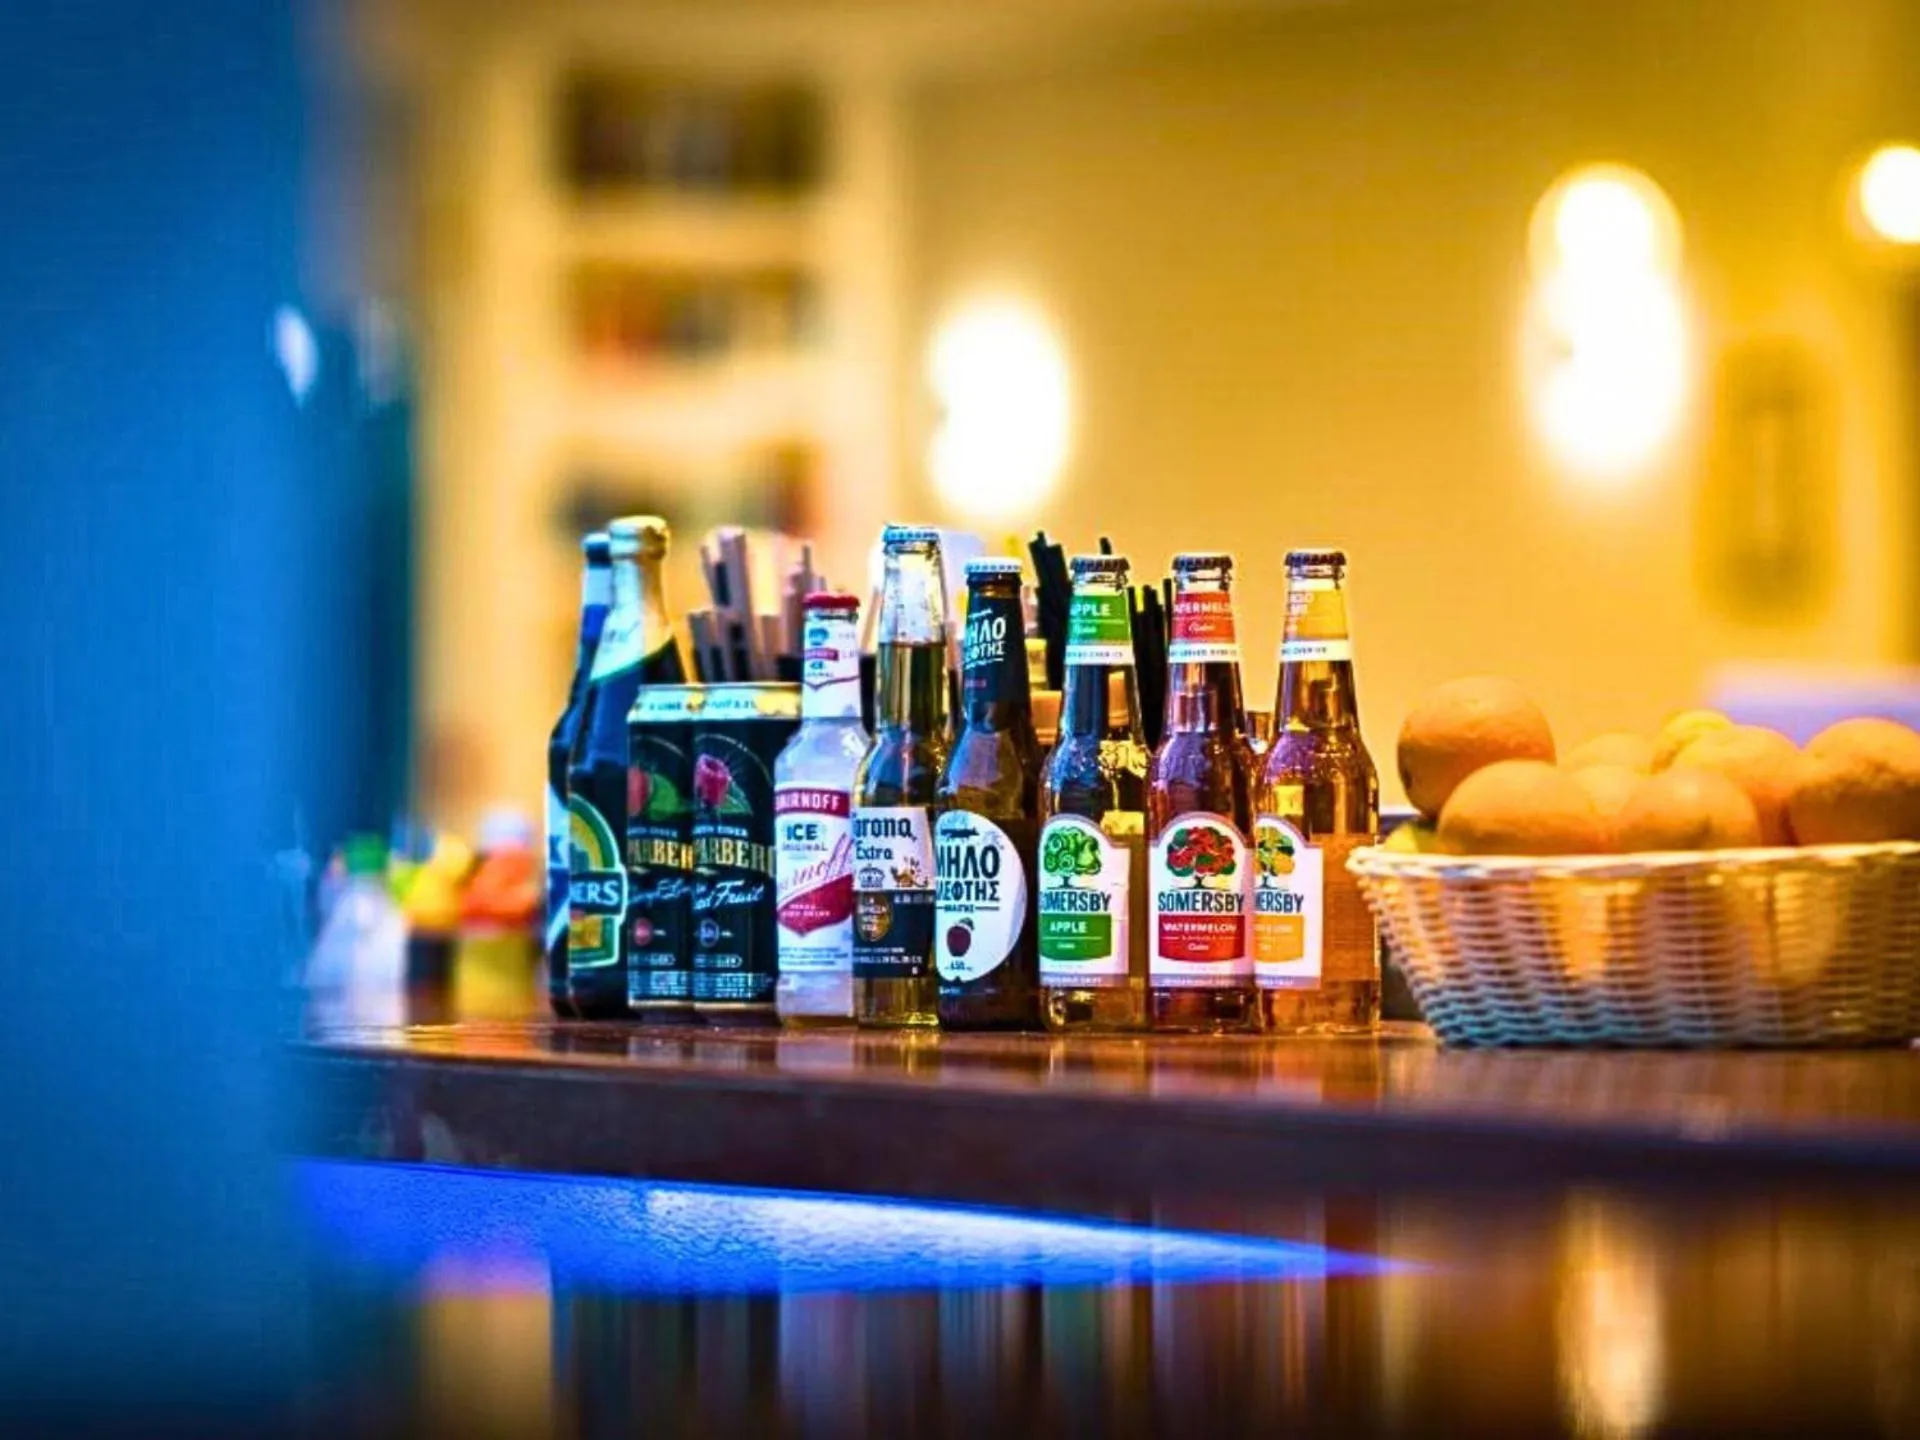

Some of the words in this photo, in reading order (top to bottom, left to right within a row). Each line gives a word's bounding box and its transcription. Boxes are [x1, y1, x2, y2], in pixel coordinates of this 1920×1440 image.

[786, 823, 819, 841] ICE
[855, 840, 894, 860] Extra
[713, 880, 765, 910] Fruit
[1158, 891, 1245, 913] SOMERSBY
[1255, 891, 1304, 914] ERSBY
[1050, 921, 1088, 934] APPLE
[1162, 923, 1238, 934] WATERMELON
